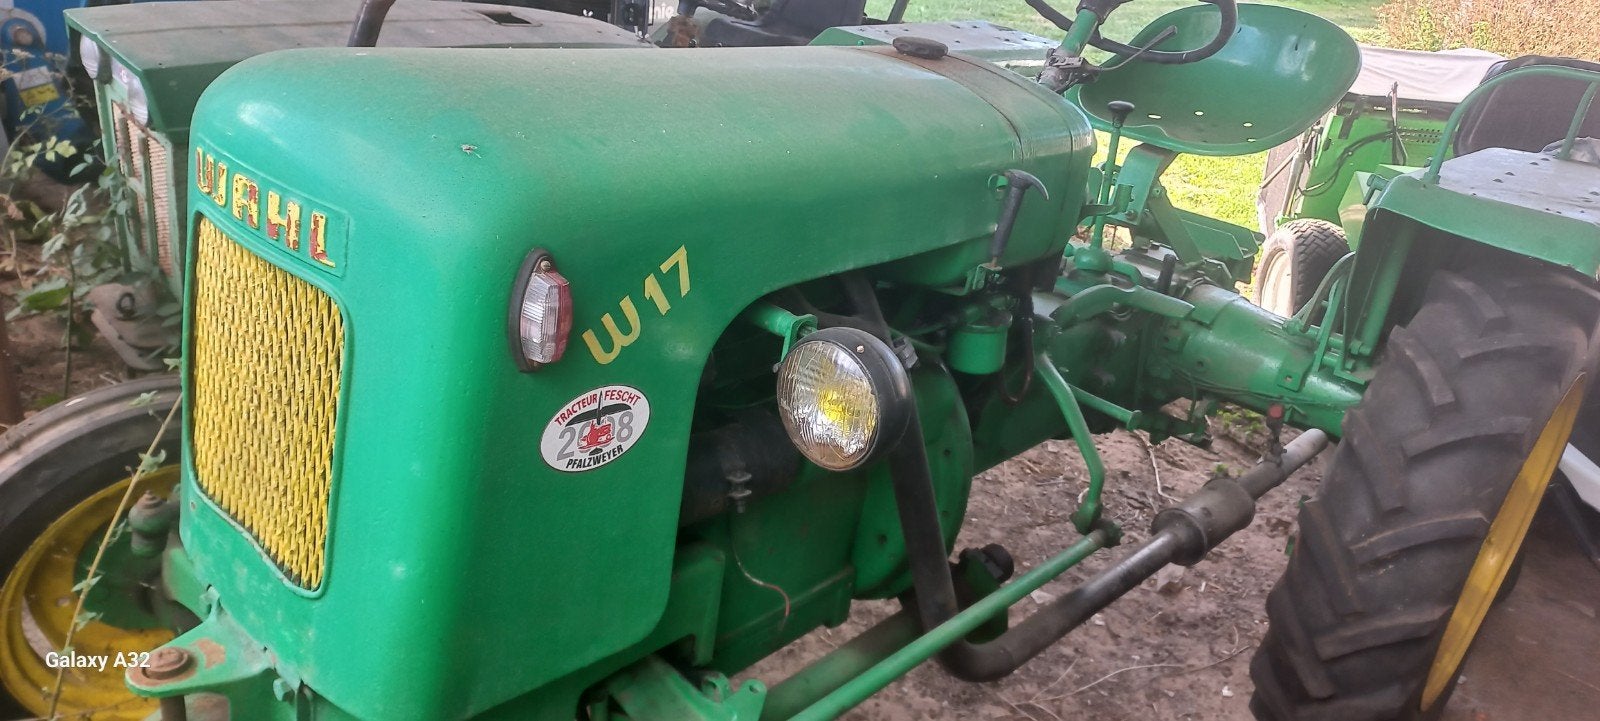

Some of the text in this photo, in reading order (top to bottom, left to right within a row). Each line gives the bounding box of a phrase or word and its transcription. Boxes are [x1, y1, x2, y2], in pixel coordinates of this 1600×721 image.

[196, 147, 336, 268] WAHL
[554, 389, 641, 426] TRACTEUR FESCHT
[565, 444, 624, 469] PFALZWEYER
